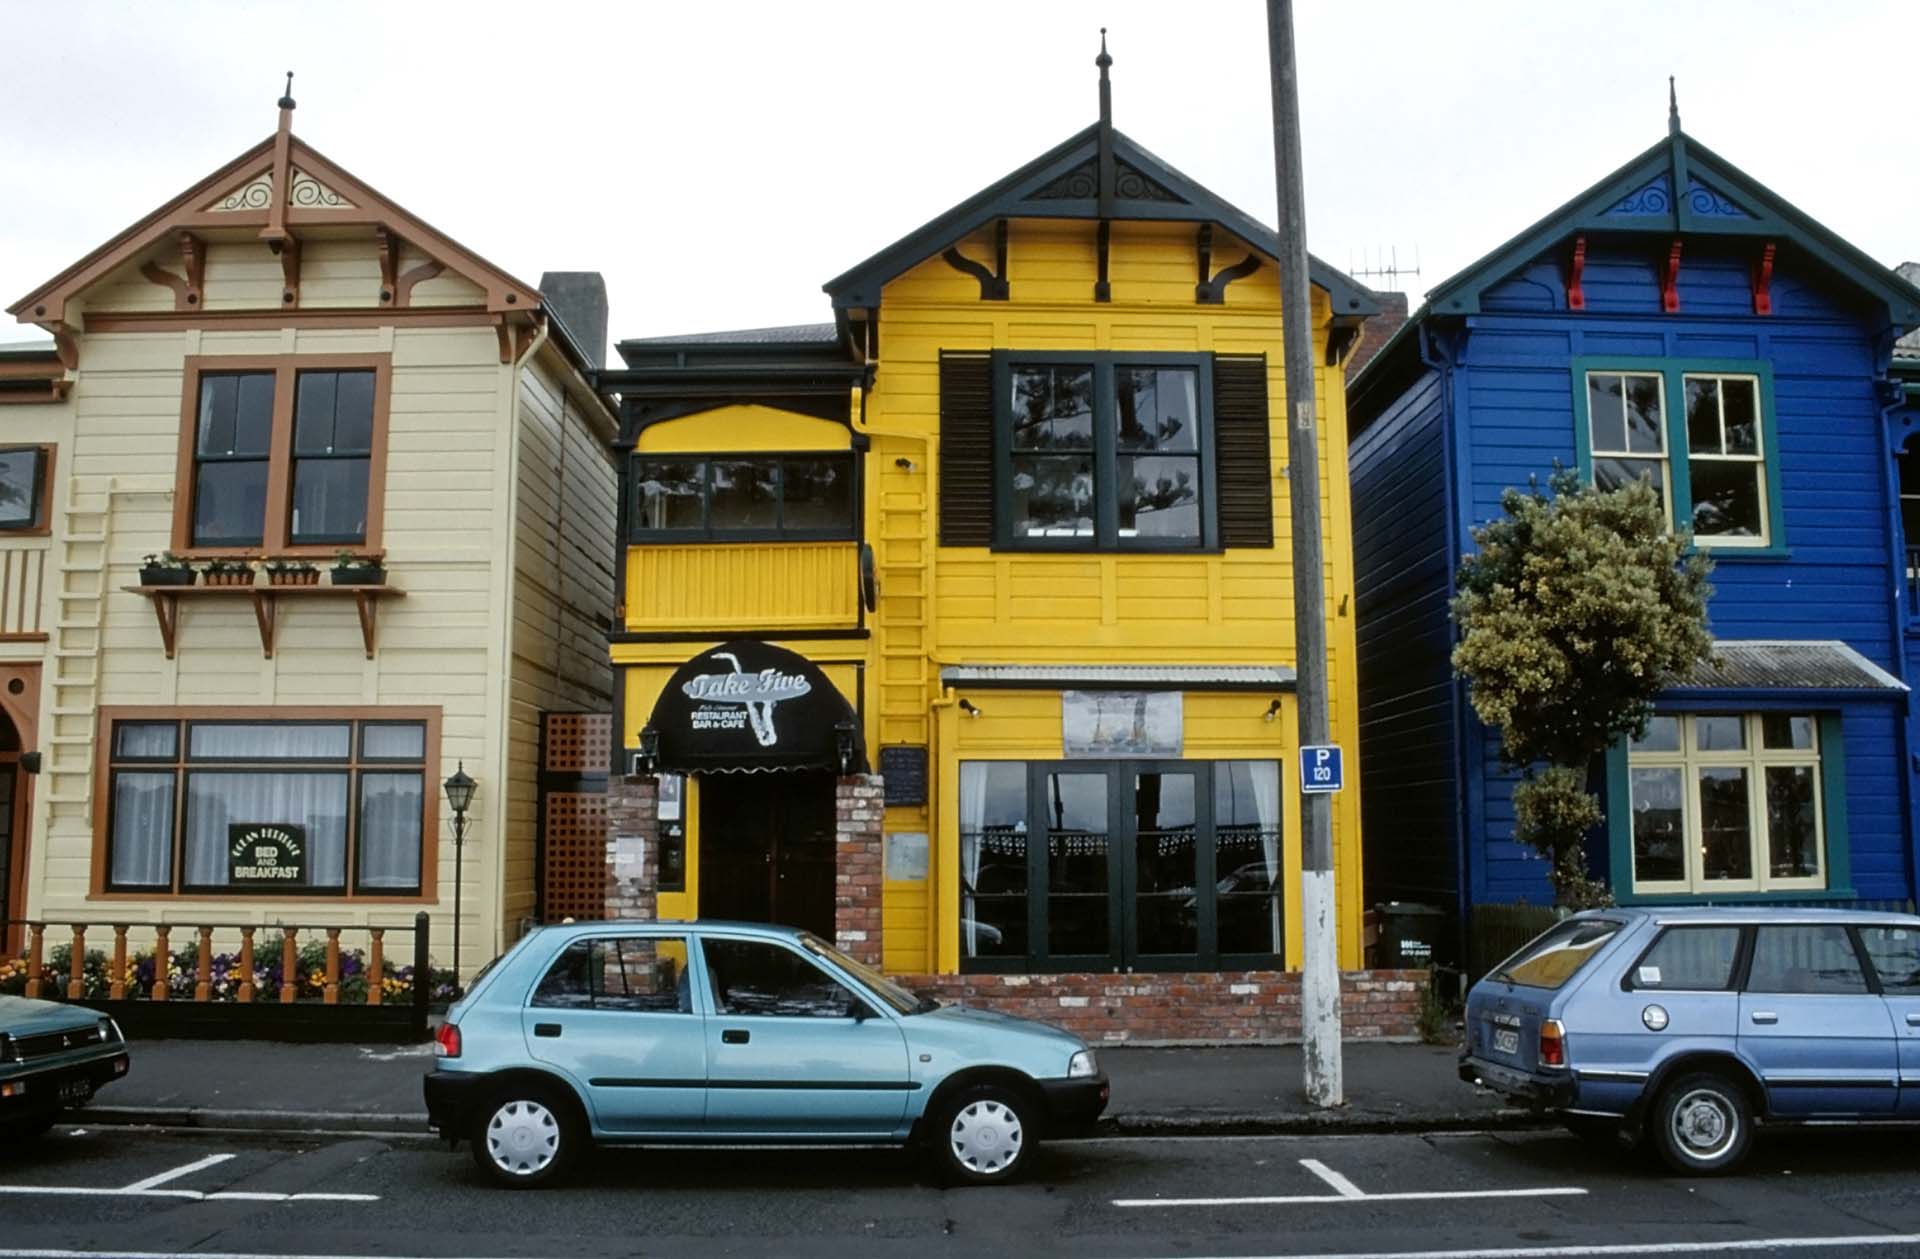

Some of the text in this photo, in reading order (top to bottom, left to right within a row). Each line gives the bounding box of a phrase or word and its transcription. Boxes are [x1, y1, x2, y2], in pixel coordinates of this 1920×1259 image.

[689, 668, 805, 699] Take Five
[692, 712, 747, 720] RESTAURANT
[693, 720, 712, 728] BAR
[1316, 750, 1330, 766] P
[1313, 767, 1331, 781] 120
[256, 847, 278, 857] BED
[236, 867, 299, 878] BREAKFAST
